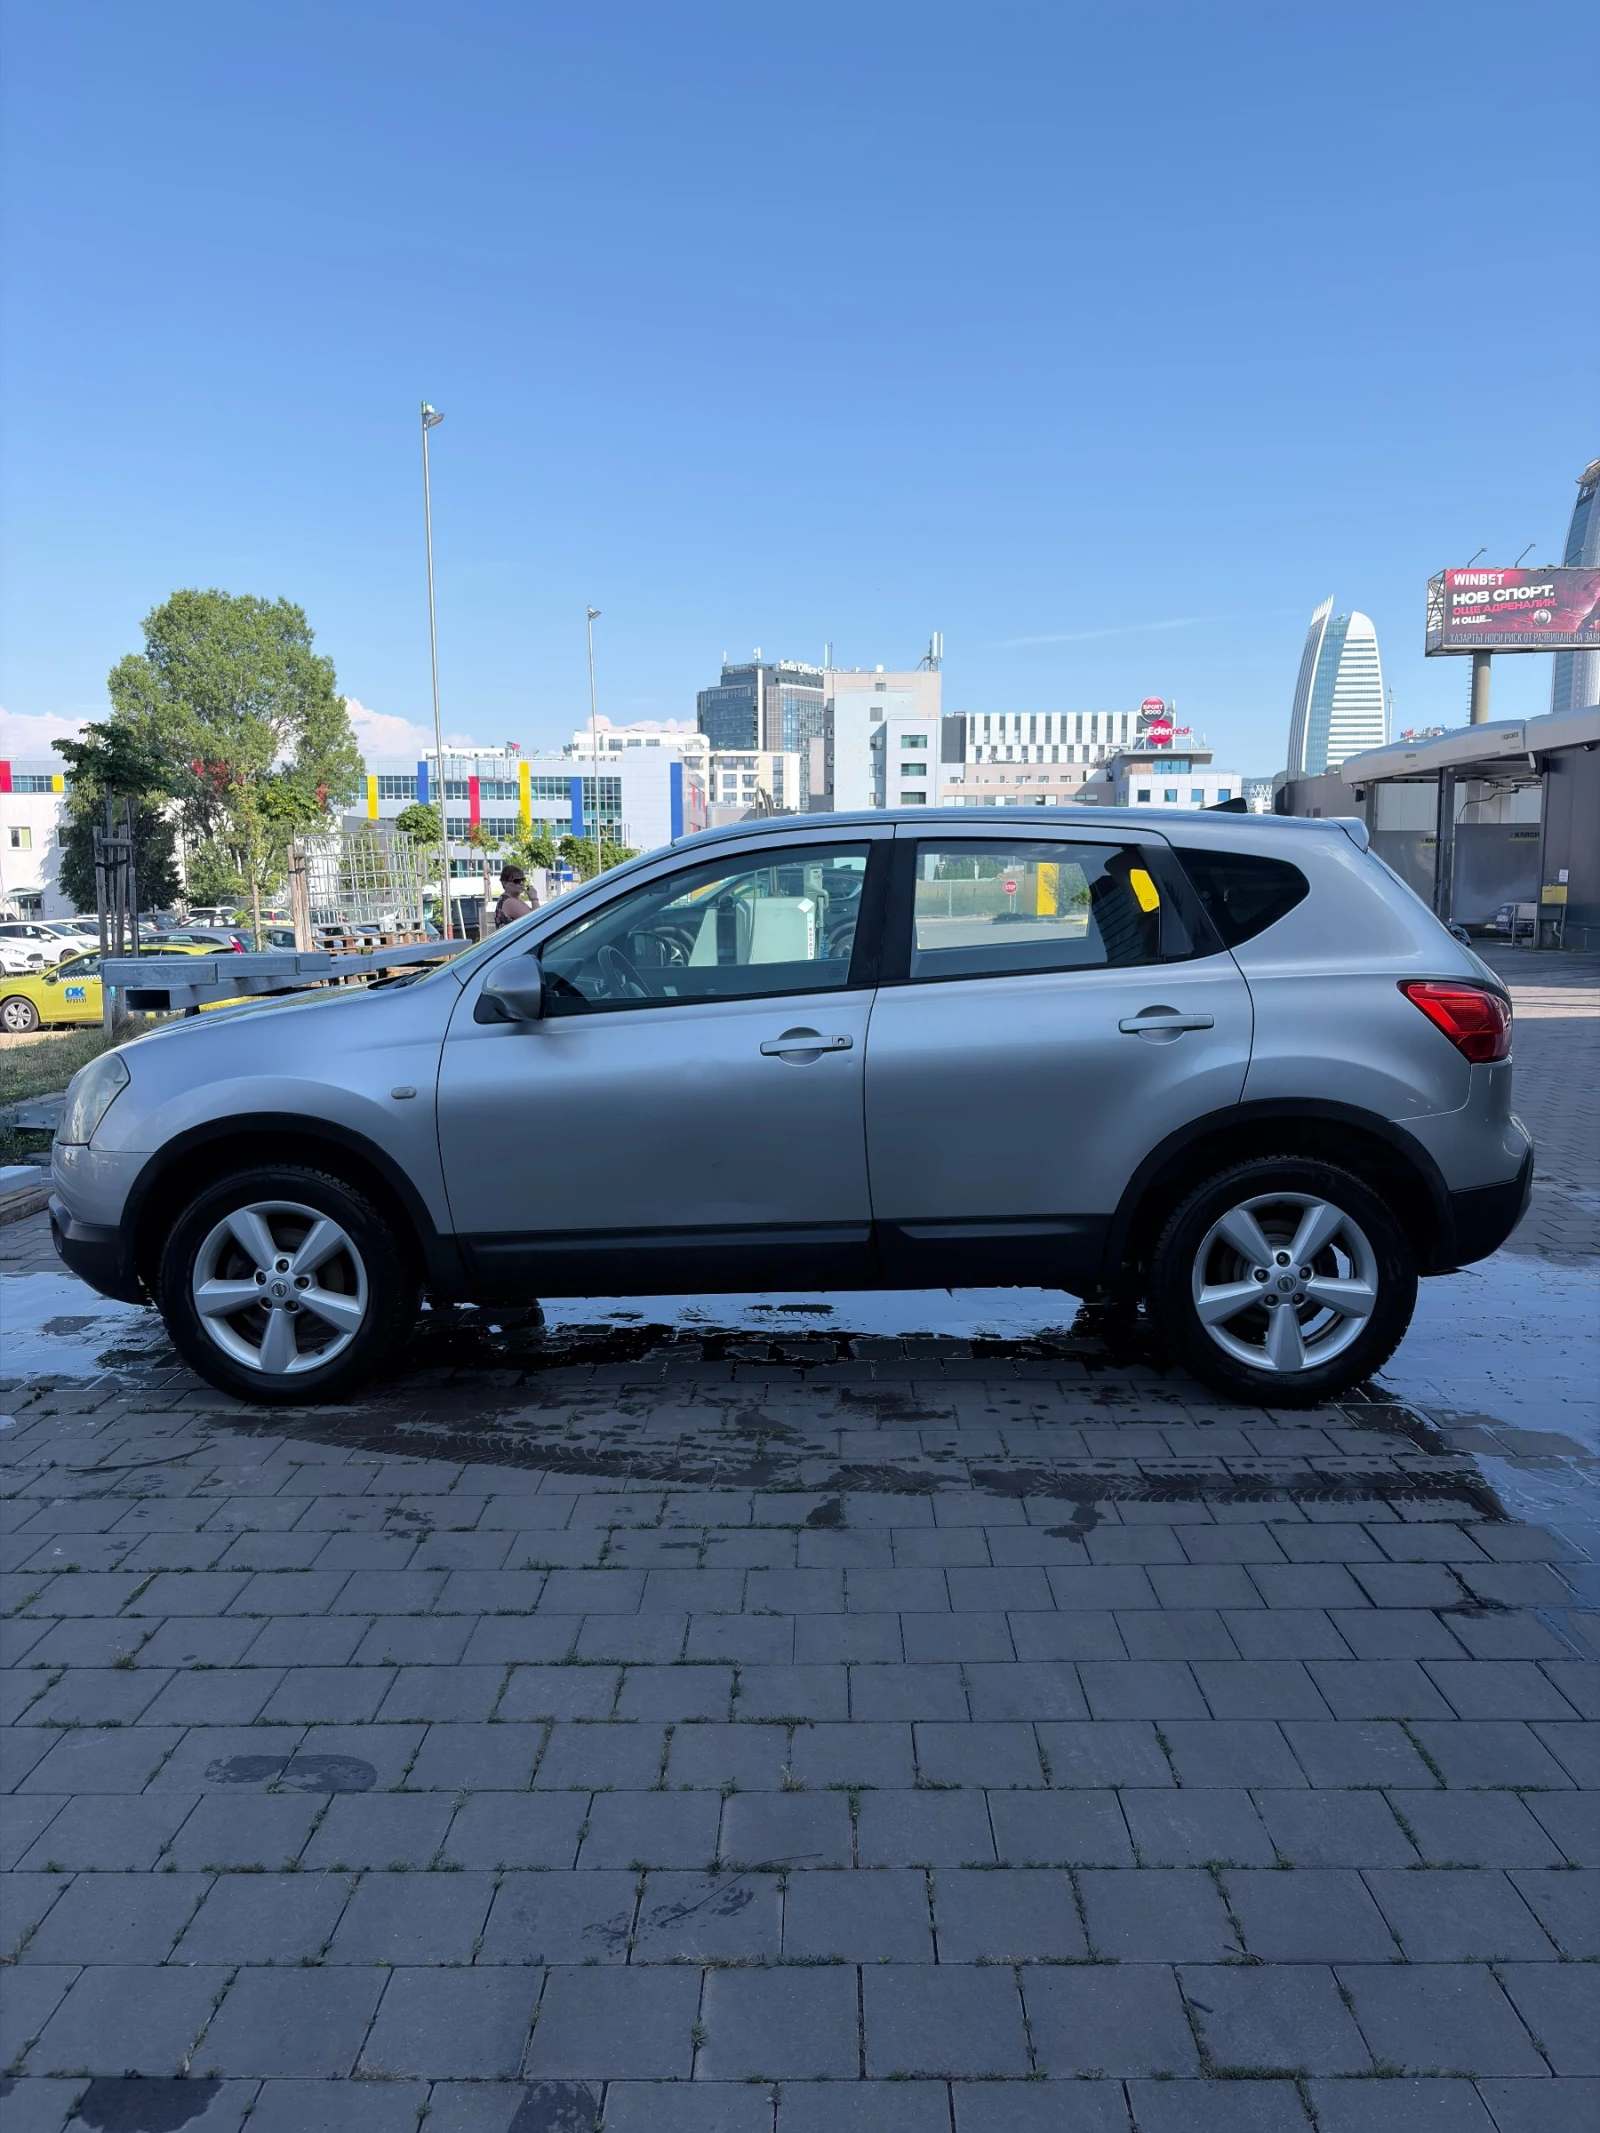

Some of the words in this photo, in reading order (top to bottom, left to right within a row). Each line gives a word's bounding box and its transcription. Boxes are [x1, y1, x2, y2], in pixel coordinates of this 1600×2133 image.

[1453, 573, 1505, 586] WINBET
[1452, 590, 1490, 606] НОВ
[1493, 584, 1555, 602] СПОРТ.
[1452, 605, 1481, 616] ОЩЕ
[1483, 598, 1558, 613] АДРЕНАЛИН.
[1452, 616, 1460, 626] И
[1484, 632, 1503, 644] НОСИ
[1504, 632, 1523, 643] РИСК
[1523, 632, 1532, 643] ОТ
[1533, 632, 1573, 643] РАЗВИВАНЕ
[1574, 632, 1583, 643] НА
[1148, 725, 1190, 736] Edenred
[65, 986, 85, 997] OK
